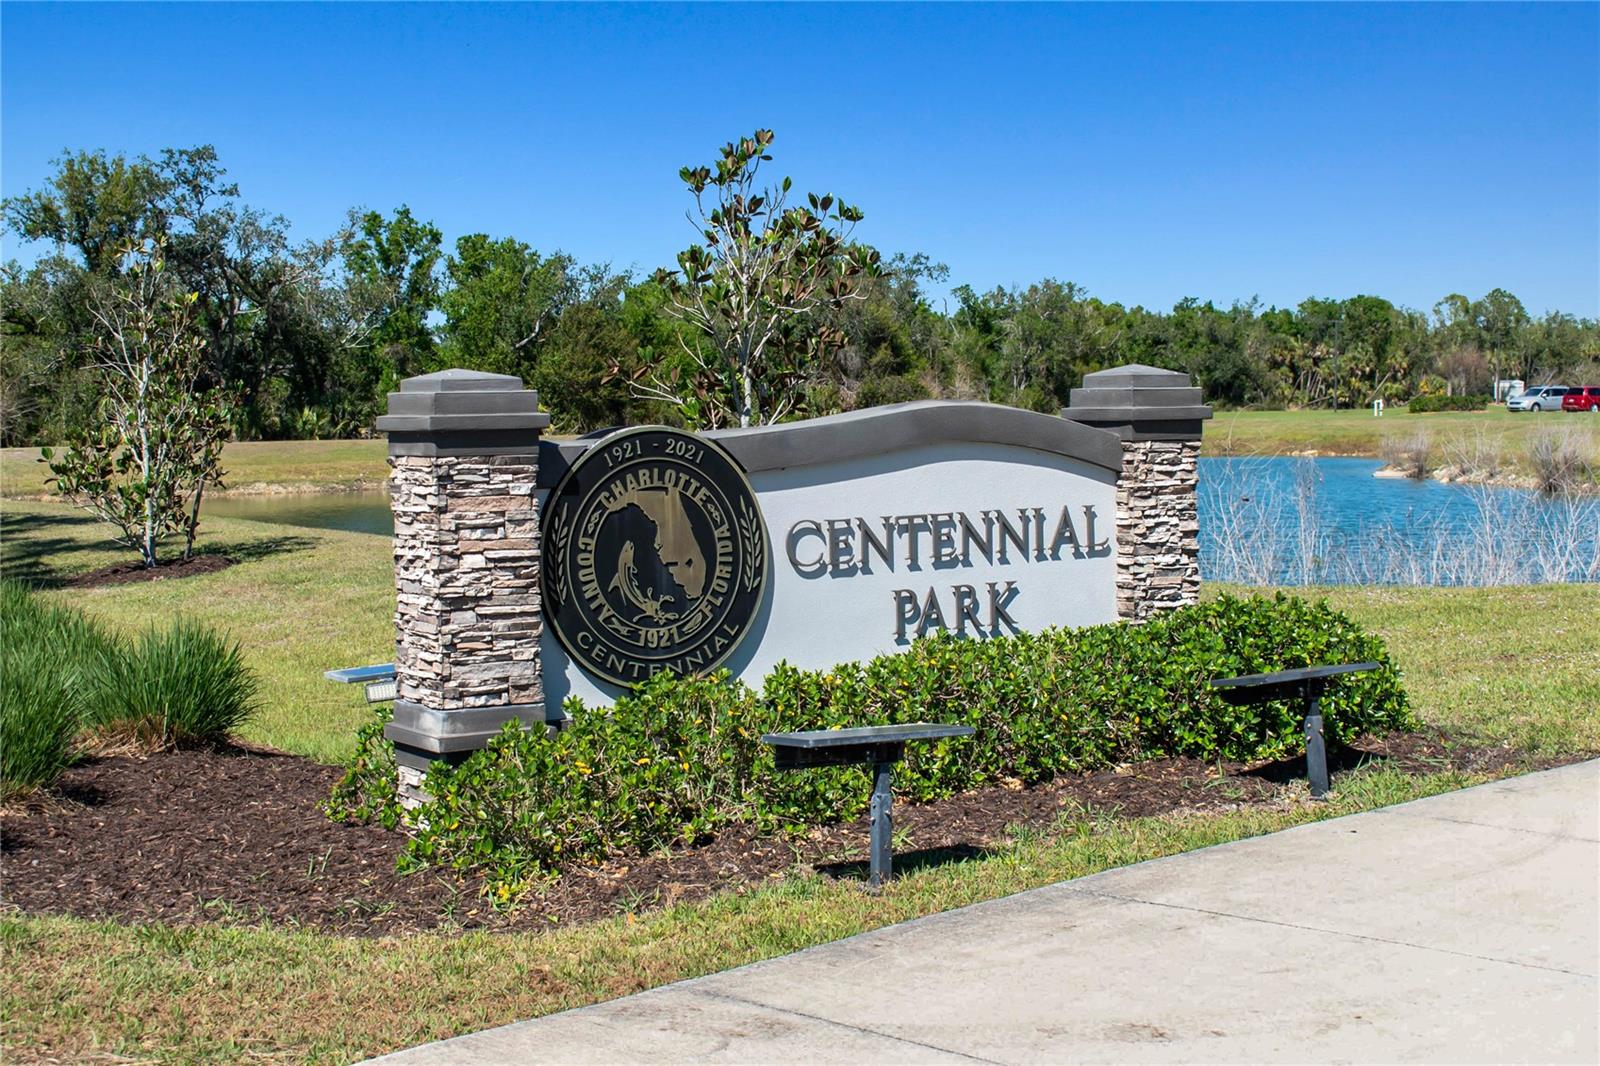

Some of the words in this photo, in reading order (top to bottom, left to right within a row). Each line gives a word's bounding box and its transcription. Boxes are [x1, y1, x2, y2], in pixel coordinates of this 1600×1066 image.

[604, 440, 641, 467] 1921
[665, 438, 704, 463] 2021
[600, 468, 709, 508] CHARLOTTE
[785, 504, 1110, 573] CENTENNIAL
[577, 538, 615, 621] COUNTY
[700, 524, 733, 614] FLORIDA
[892, 580, 1018, 635] PARK
[576, 624, 739, 678] CENTENNIAL
[639, 626, 680, 648] 1921
